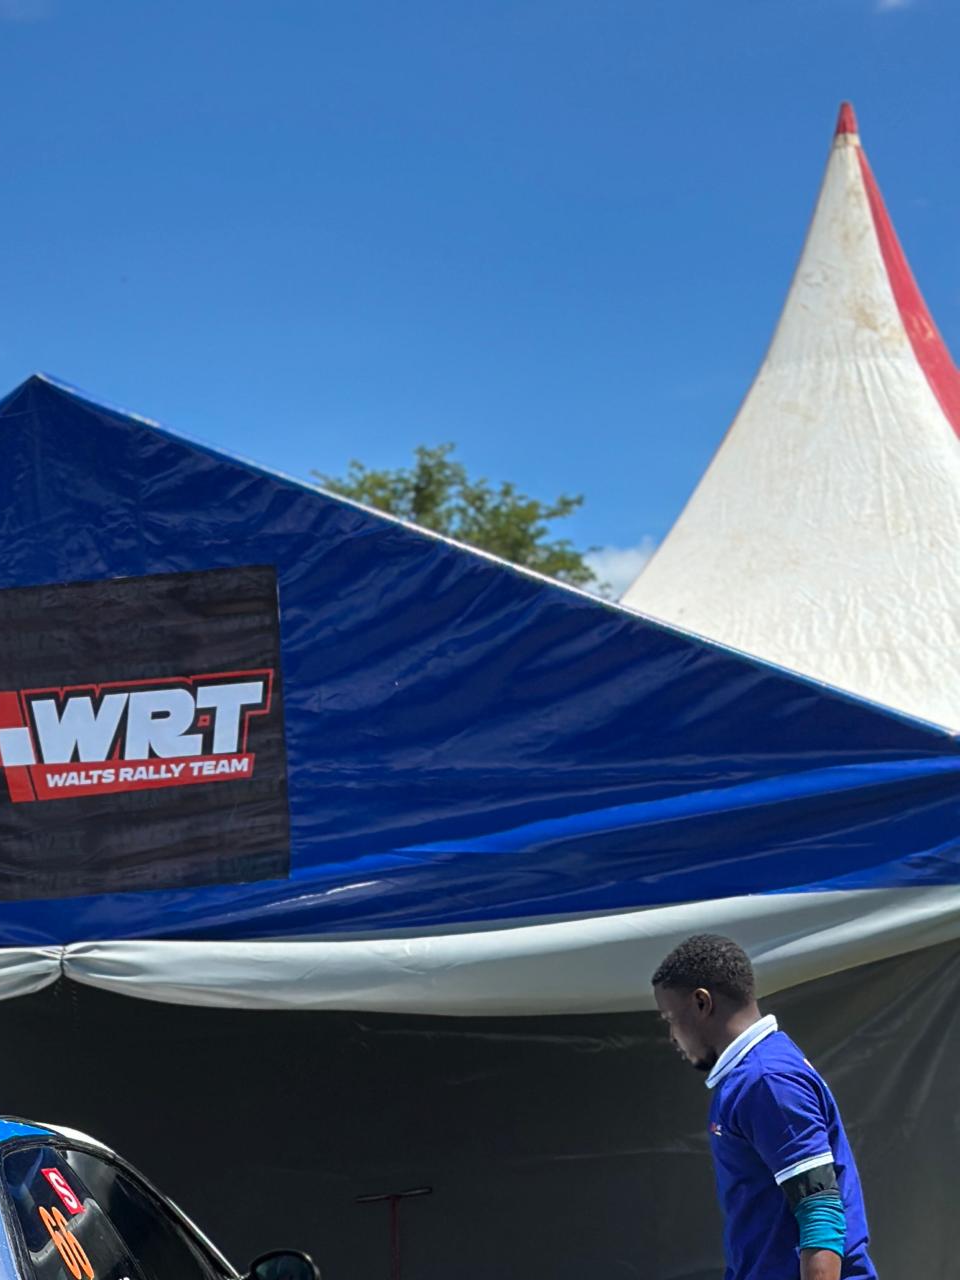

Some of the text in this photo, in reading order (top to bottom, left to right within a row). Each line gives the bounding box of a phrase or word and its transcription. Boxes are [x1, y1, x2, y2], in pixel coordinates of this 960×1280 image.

[31, 681, 264, 765] WRT
[46, 758, 248, 788] WALTS RALLY TEAM
